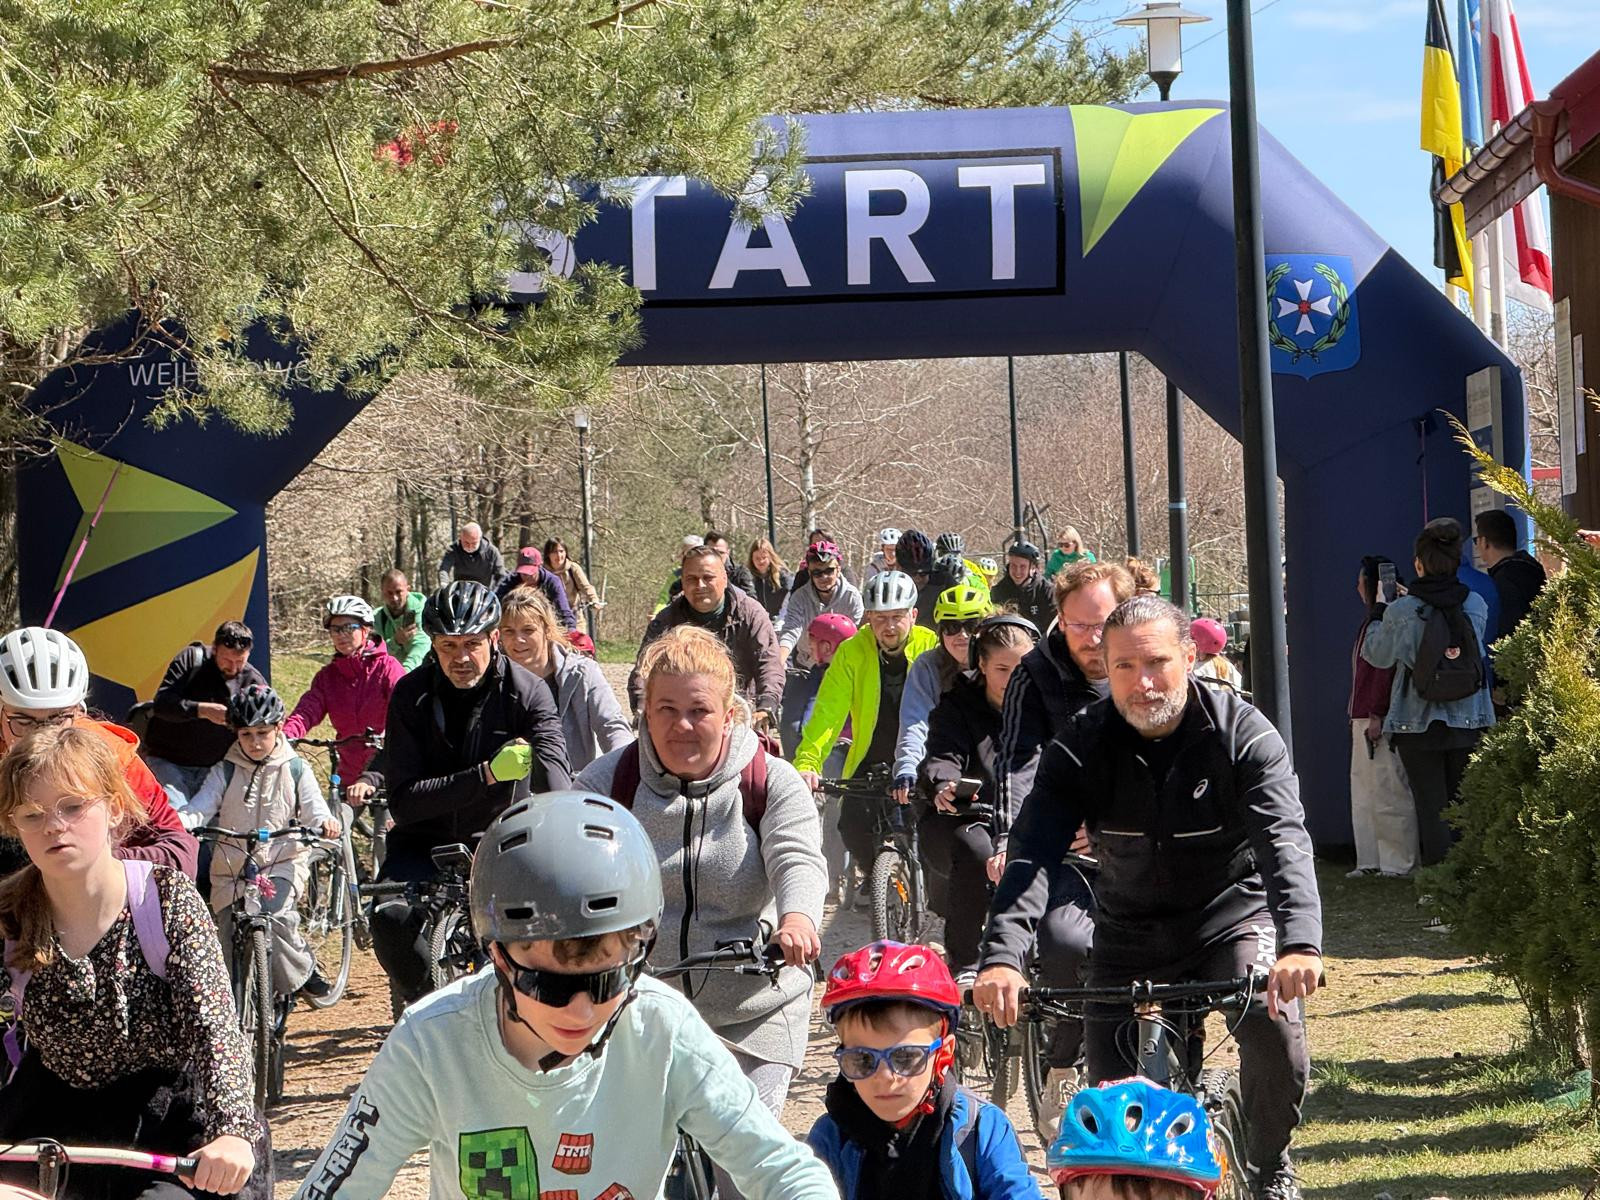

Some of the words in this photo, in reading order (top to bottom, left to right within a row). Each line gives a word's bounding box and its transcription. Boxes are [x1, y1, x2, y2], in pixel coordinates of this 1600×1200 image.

[492, 163, 1046, 293] START
[128, 360, 313, 387] WEJHWO
[563, 1147, 588, 1157] TNT
